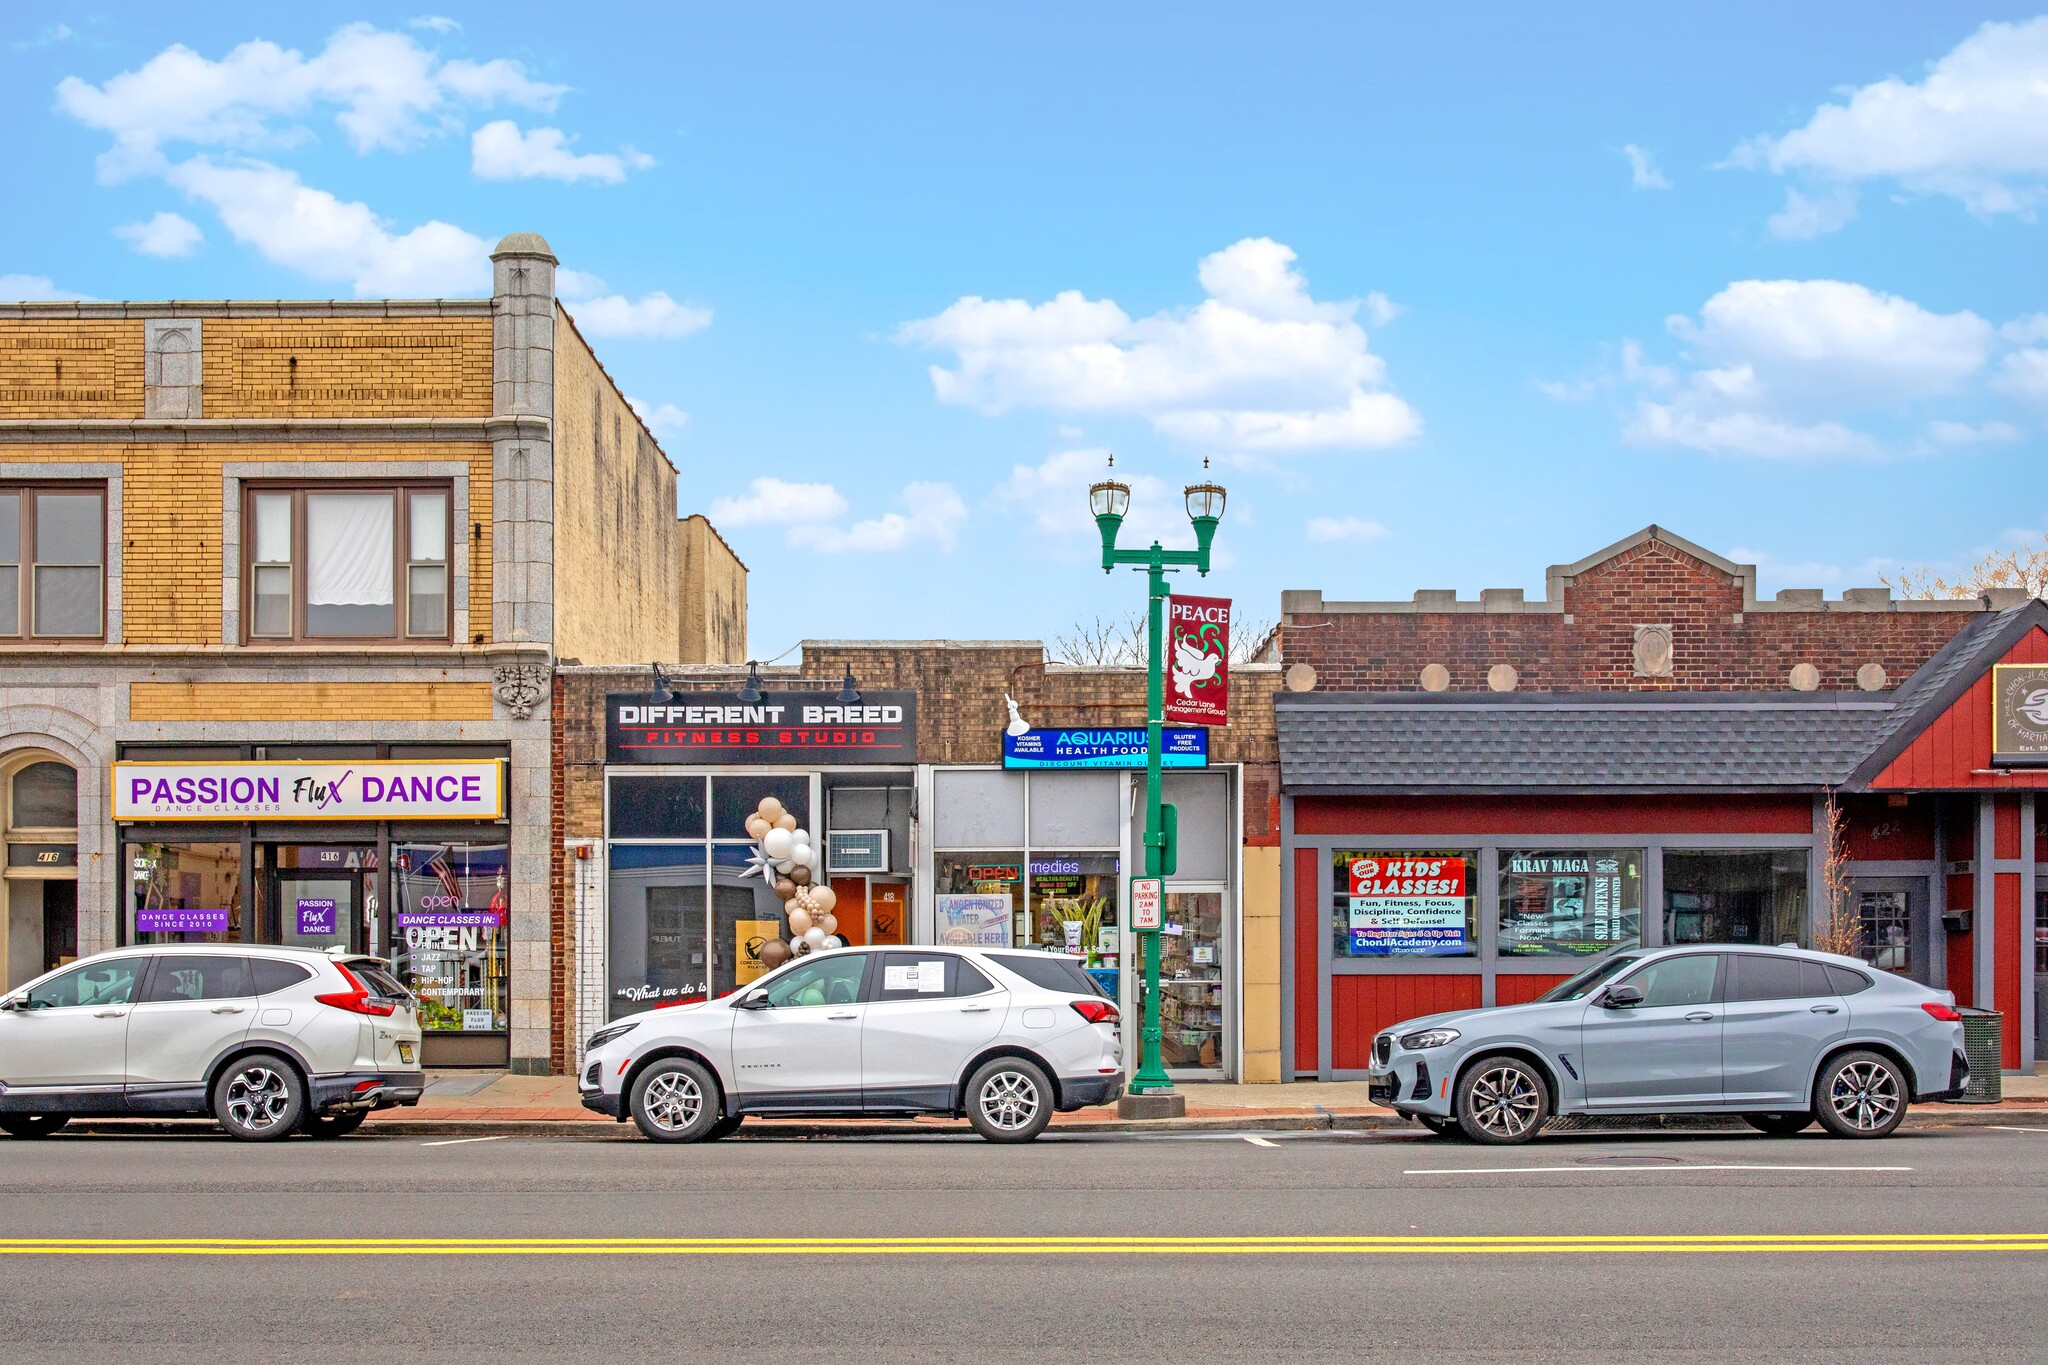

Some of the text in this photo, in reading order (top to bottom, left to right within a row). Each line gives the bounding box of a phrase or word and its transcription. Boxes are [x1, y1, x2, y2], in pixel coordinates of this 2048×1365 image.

[1171, 604, 1229, 623] PEACE
[2005, 670, 2035, 696] CHON-JI
[1176, 698, 1216, 709] Cedar Lane
[619, 705, 903, 724] DIFFERENT BREED
[1166, 704, 1226, 716] Management Group
[2007, 718, 2020, 729] OF
[647, 731, 875, 743] FITNESS STUDIO
[1056, 747, 1108, 755] HEALTH
[131, 777, 280, 804] PASSION
[362, 776, 481, 803] DANCE
[214, 804, 281, 812] CLASSES
[38, 853, 58, 861] 416
[321, 852, 339, 860] 416
[1356, 862, 1373, 871] JOIN
[1385, 860, 1448, 877] KIDS'
[1511, 859, 1549, 873] KRAV
[1552, 859, 1589, 873] MAGA
[969, 867, 1018, 880] OPEN
[1358, 868, 1375, 877] OUR
[1141, 883, 1151, 891] NO
[1357, 879, 1459, 895] CLASSES!
[1134, 891, 1158, 900] PARKING
[1594, 876, 1609, 917] DEFENSE
[420, 896, 459, 911] open
[1354, 908, 1404, 916] Discipline,
[402, 916, 496, 924] DANCE CLASSES IN:
[1403, 917, 1445, 925] Defense!
[303, 925, 331, 933] DANCE
[1367, 930, 1398, 938] Register
[1398, 930, 1416, 938] Ages
[1432, 930, 1442, 938] Up
[1594, 918, 1609, 940] SELF
[405, 926, 478, 951] OPEN
[984, 932, 1009, 944] HERE!
[1355, 938, 1462, 947] ChonJiAcademy.com
[421, 953, 441, 961] JAZZ
[421, 965, 436, 973] TAP
[421, 988, 485, 996] CONTEMPORARY
[663, 987, 679, 997] we
[680, 983, 695, 995] do
[698, 982, 707, 993] is
